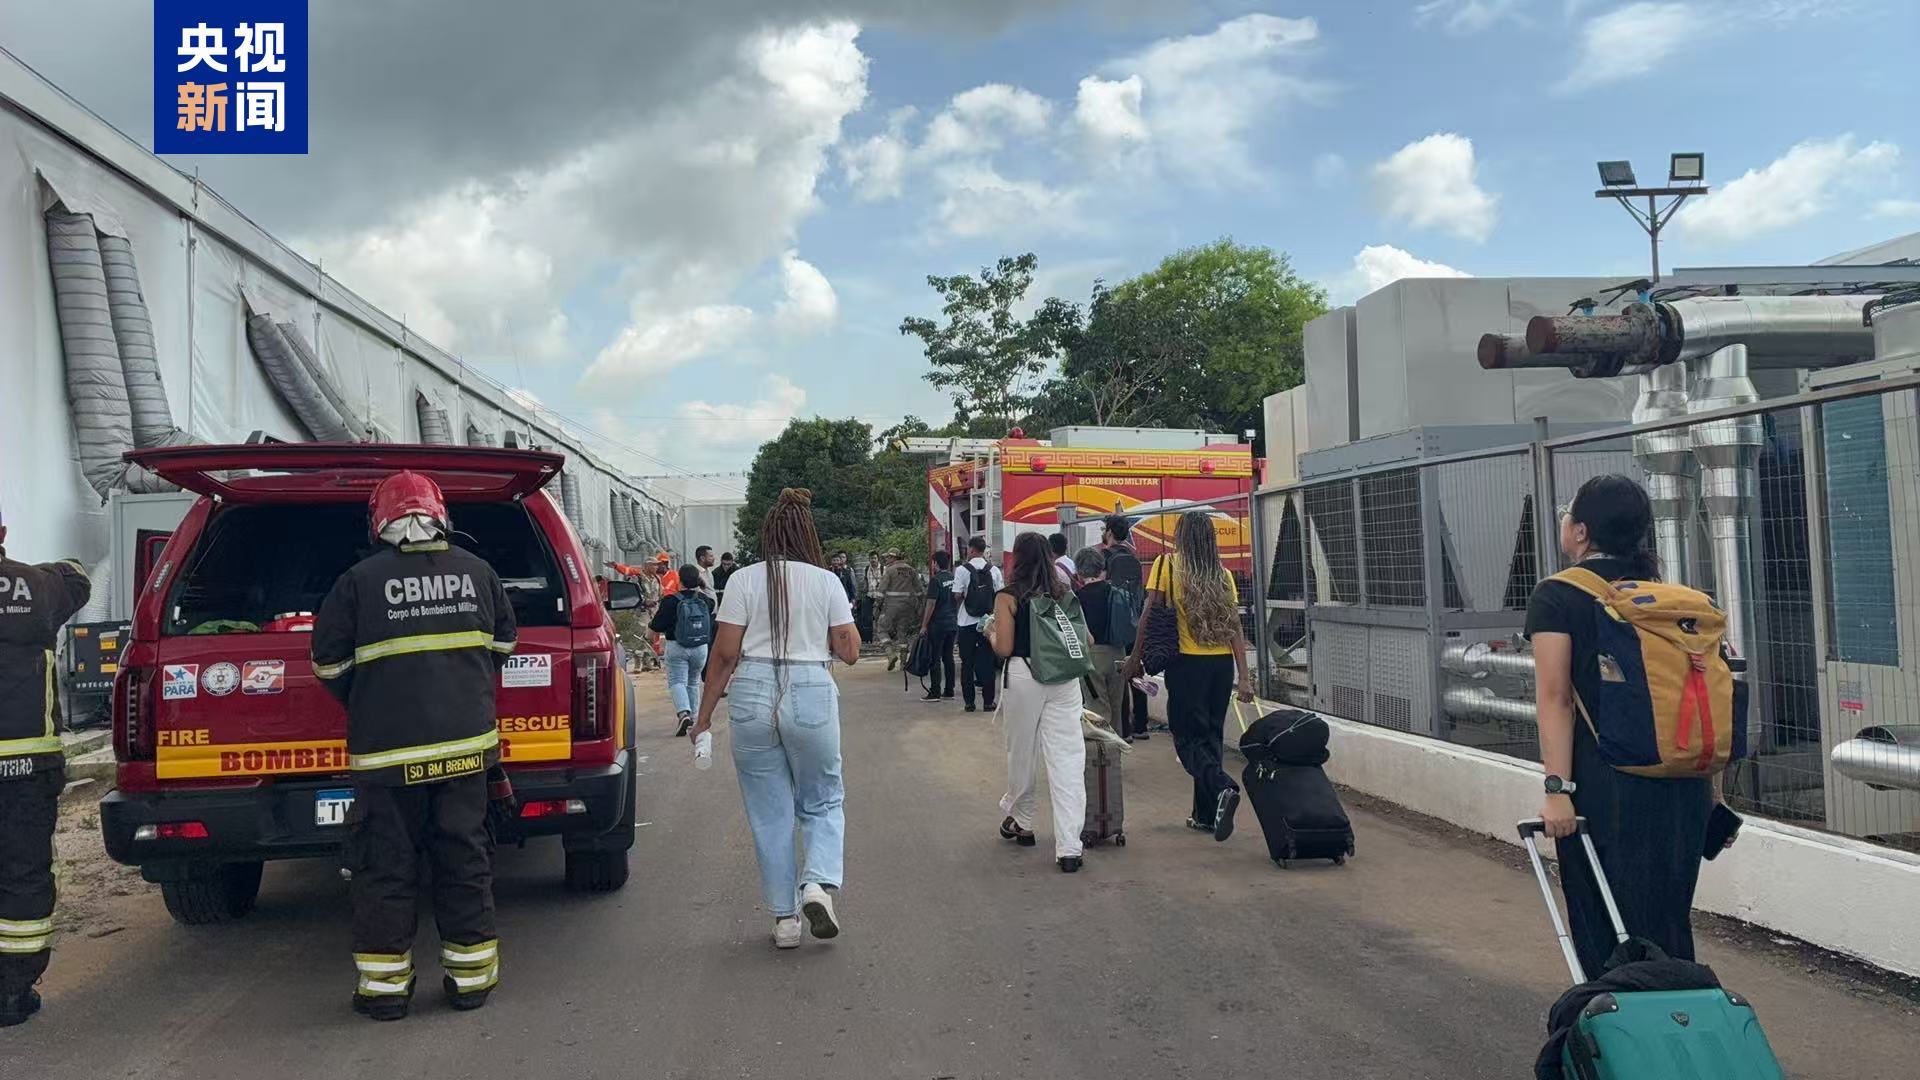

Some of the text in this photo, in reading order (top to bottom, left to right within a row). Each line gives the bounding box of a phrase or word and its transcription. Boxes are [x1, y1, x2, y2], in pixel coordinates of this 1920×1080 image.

[1079, 477, 1159, 486] BOMBEIRO MILITAR
[1213, 527, 1237, 536] SCUE
[385, 574, 477, 604] CBMPA
[6, 605, 31, 614] Militar
[387, 601, 478, 620] Corpo de Bombeiros Militar
[157, 728, 210, 746] FIRE
[409, 755, 480, 779] SD BM BRENNO
